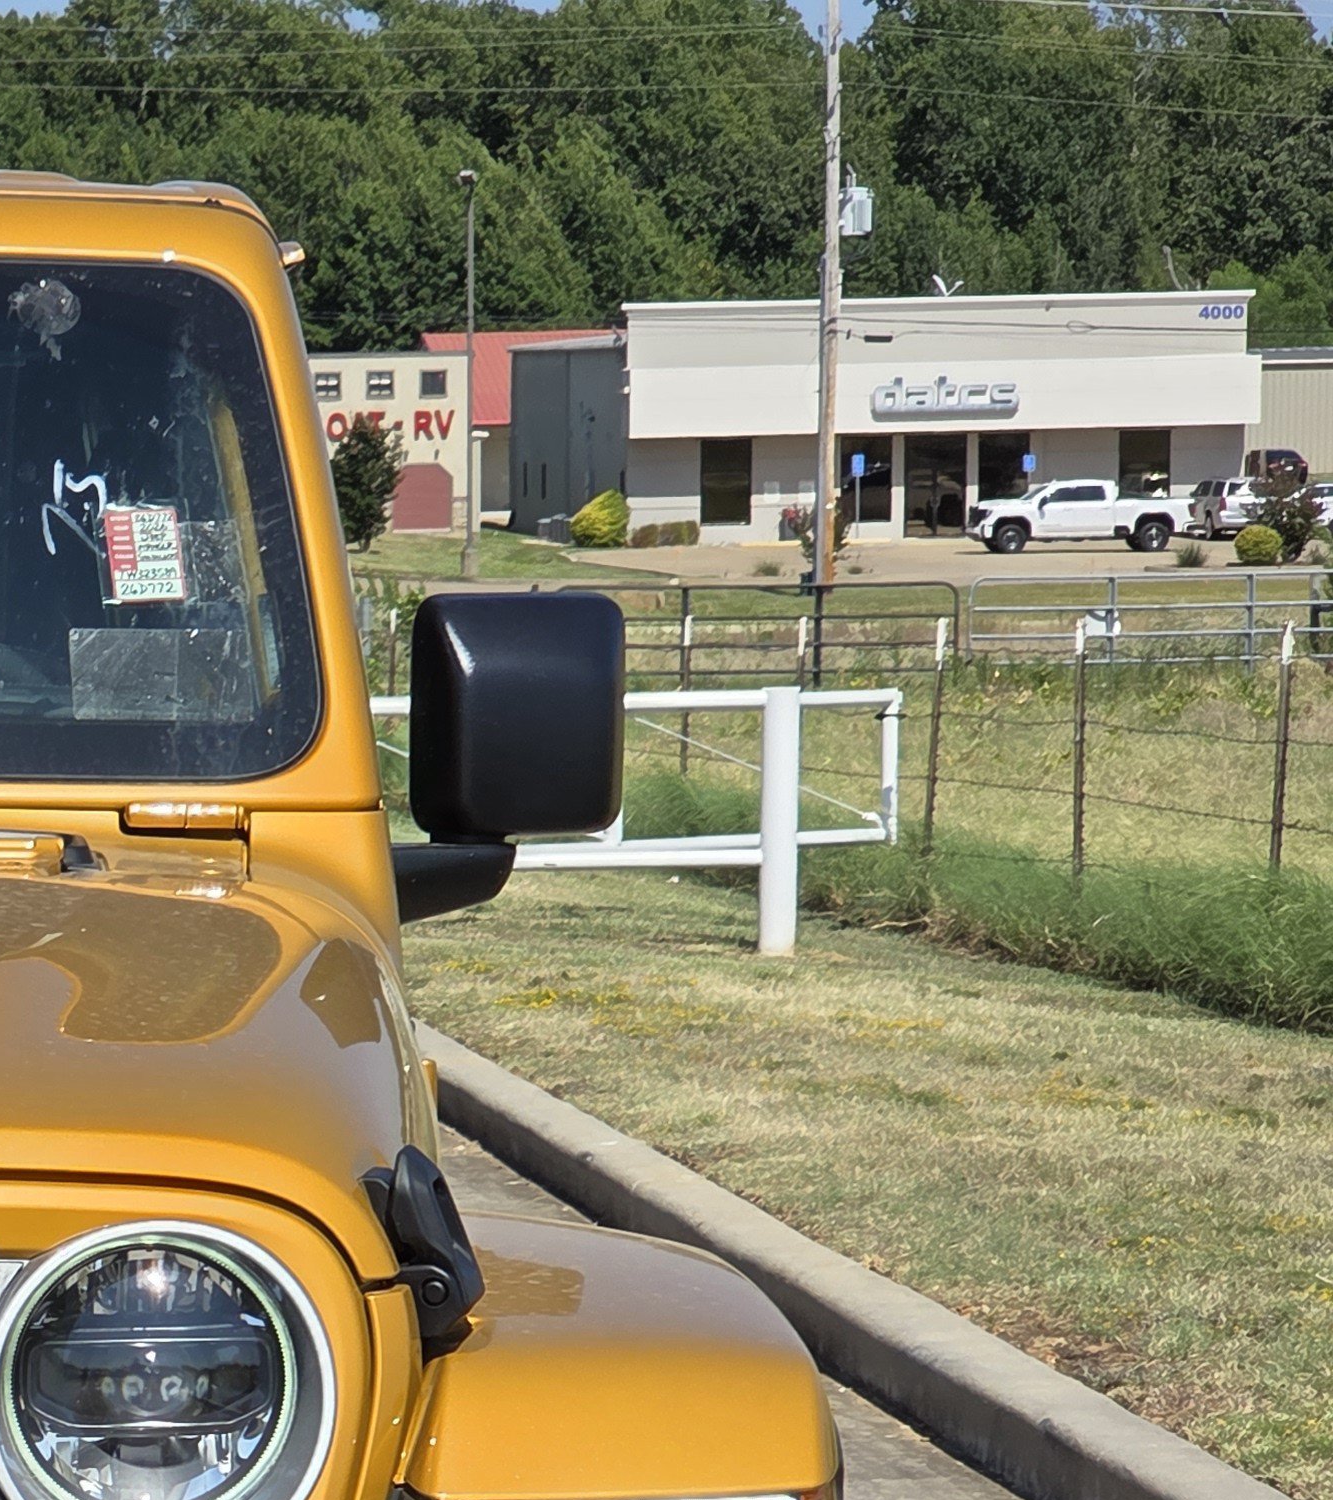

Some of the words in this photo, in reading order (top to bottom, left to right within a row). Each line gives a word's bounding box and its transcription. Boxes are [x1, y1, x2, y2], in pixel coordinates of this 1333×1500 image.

[1198, 305, 1245, 320] 4000
[414, 410, 455, 441] RV
[120, 582, 178, 595] 26D772
